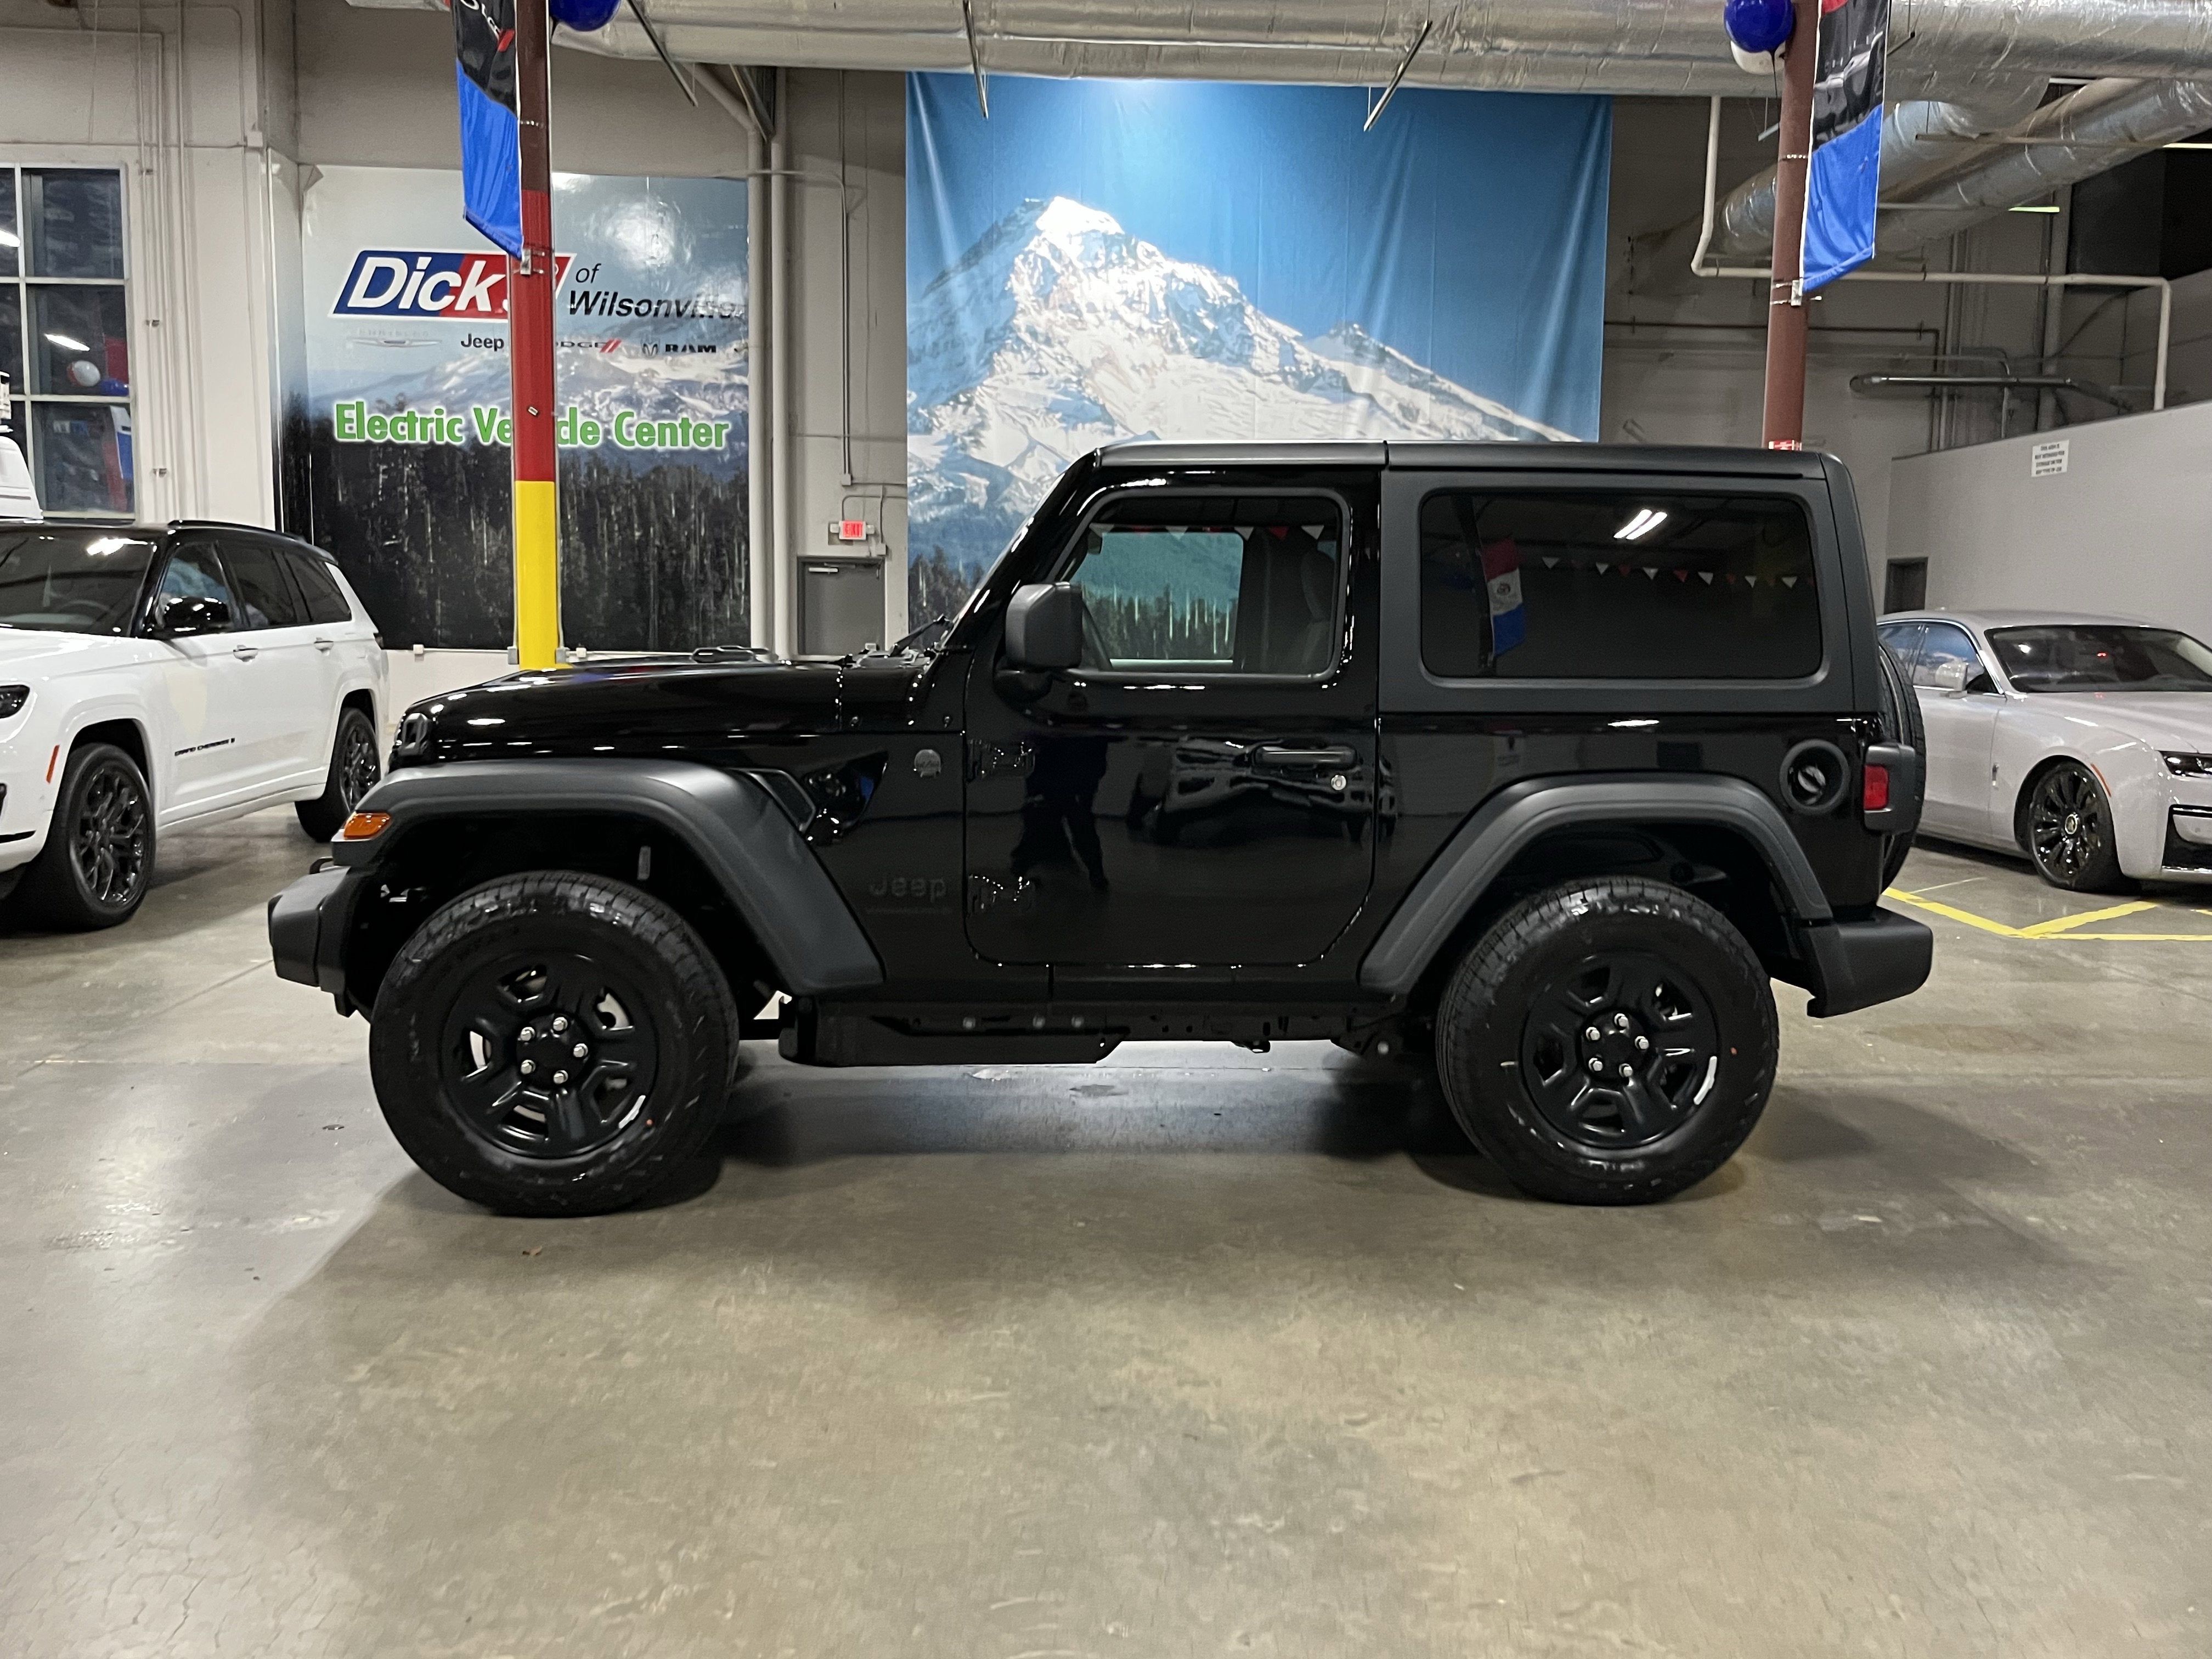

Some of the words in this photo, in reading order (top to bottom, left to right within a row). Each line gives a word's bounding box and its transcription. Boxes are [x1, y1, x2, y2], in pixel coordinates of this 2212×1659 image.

[347, 256, 508, 312] Dick
[575, 263, 601, 284] of
[569, 290, 735, 318] Wilsonvi
[461, 333, 505, 352] Jeep
[665, 343, 716, 353] RAM
[336, 402, 463, 443] Electric
[473, 407, 600, 445] Vecle
[615, 411, 730, 448] Center
[870, 877, 947, 903] Jeep
